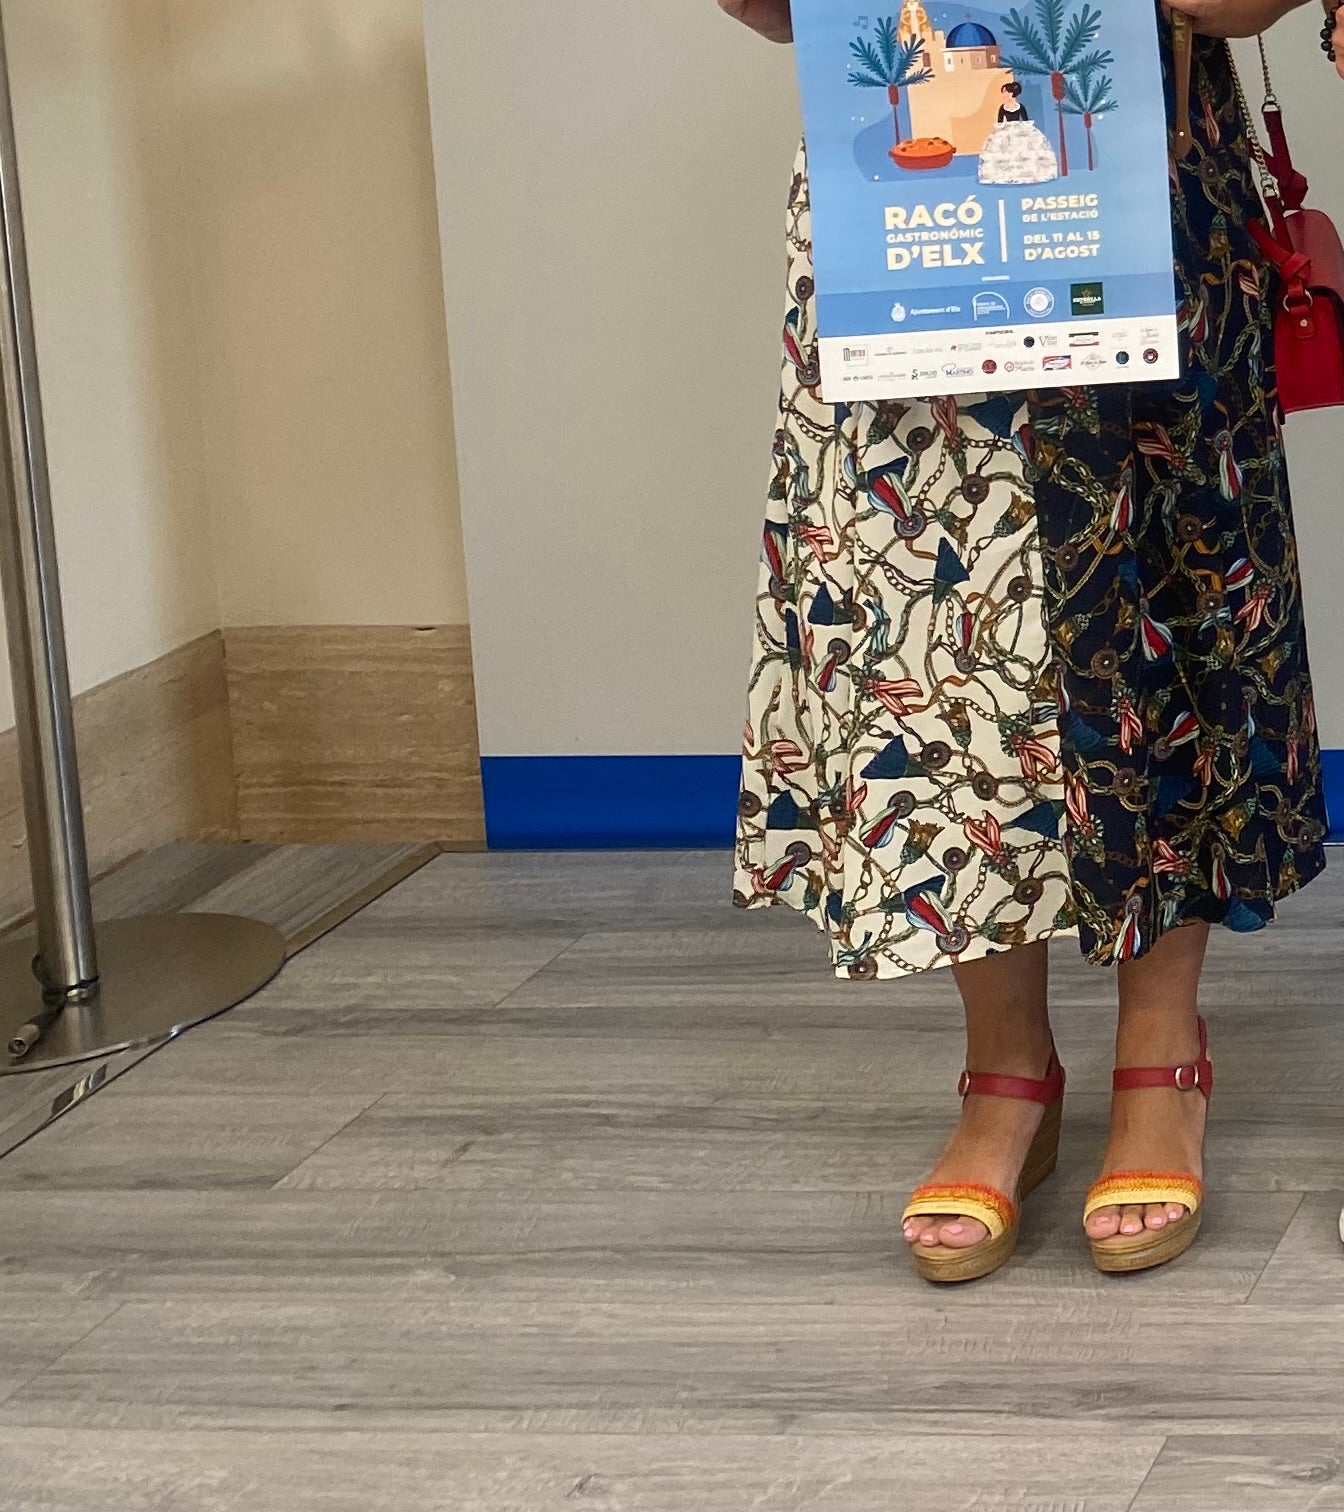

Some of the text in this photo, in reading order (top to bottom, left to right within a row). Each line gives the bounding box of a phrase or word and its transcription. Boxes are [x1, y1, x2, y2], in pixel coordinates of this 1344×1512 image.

[1021, 194, 1098, 211] PASSEIG
[884, 195, 983, 230] RACÓ
[1022, 209, 1099, 223] DE L'ESTACIÓ
[886, 228, 984, 244] GASTRONÓMIC
[1023, 230, 1100, 245] DEL 11 AL 15
[886, 242, 985, 271] D'ELX
[1024, 244, 1101, 261] D'AGOST
